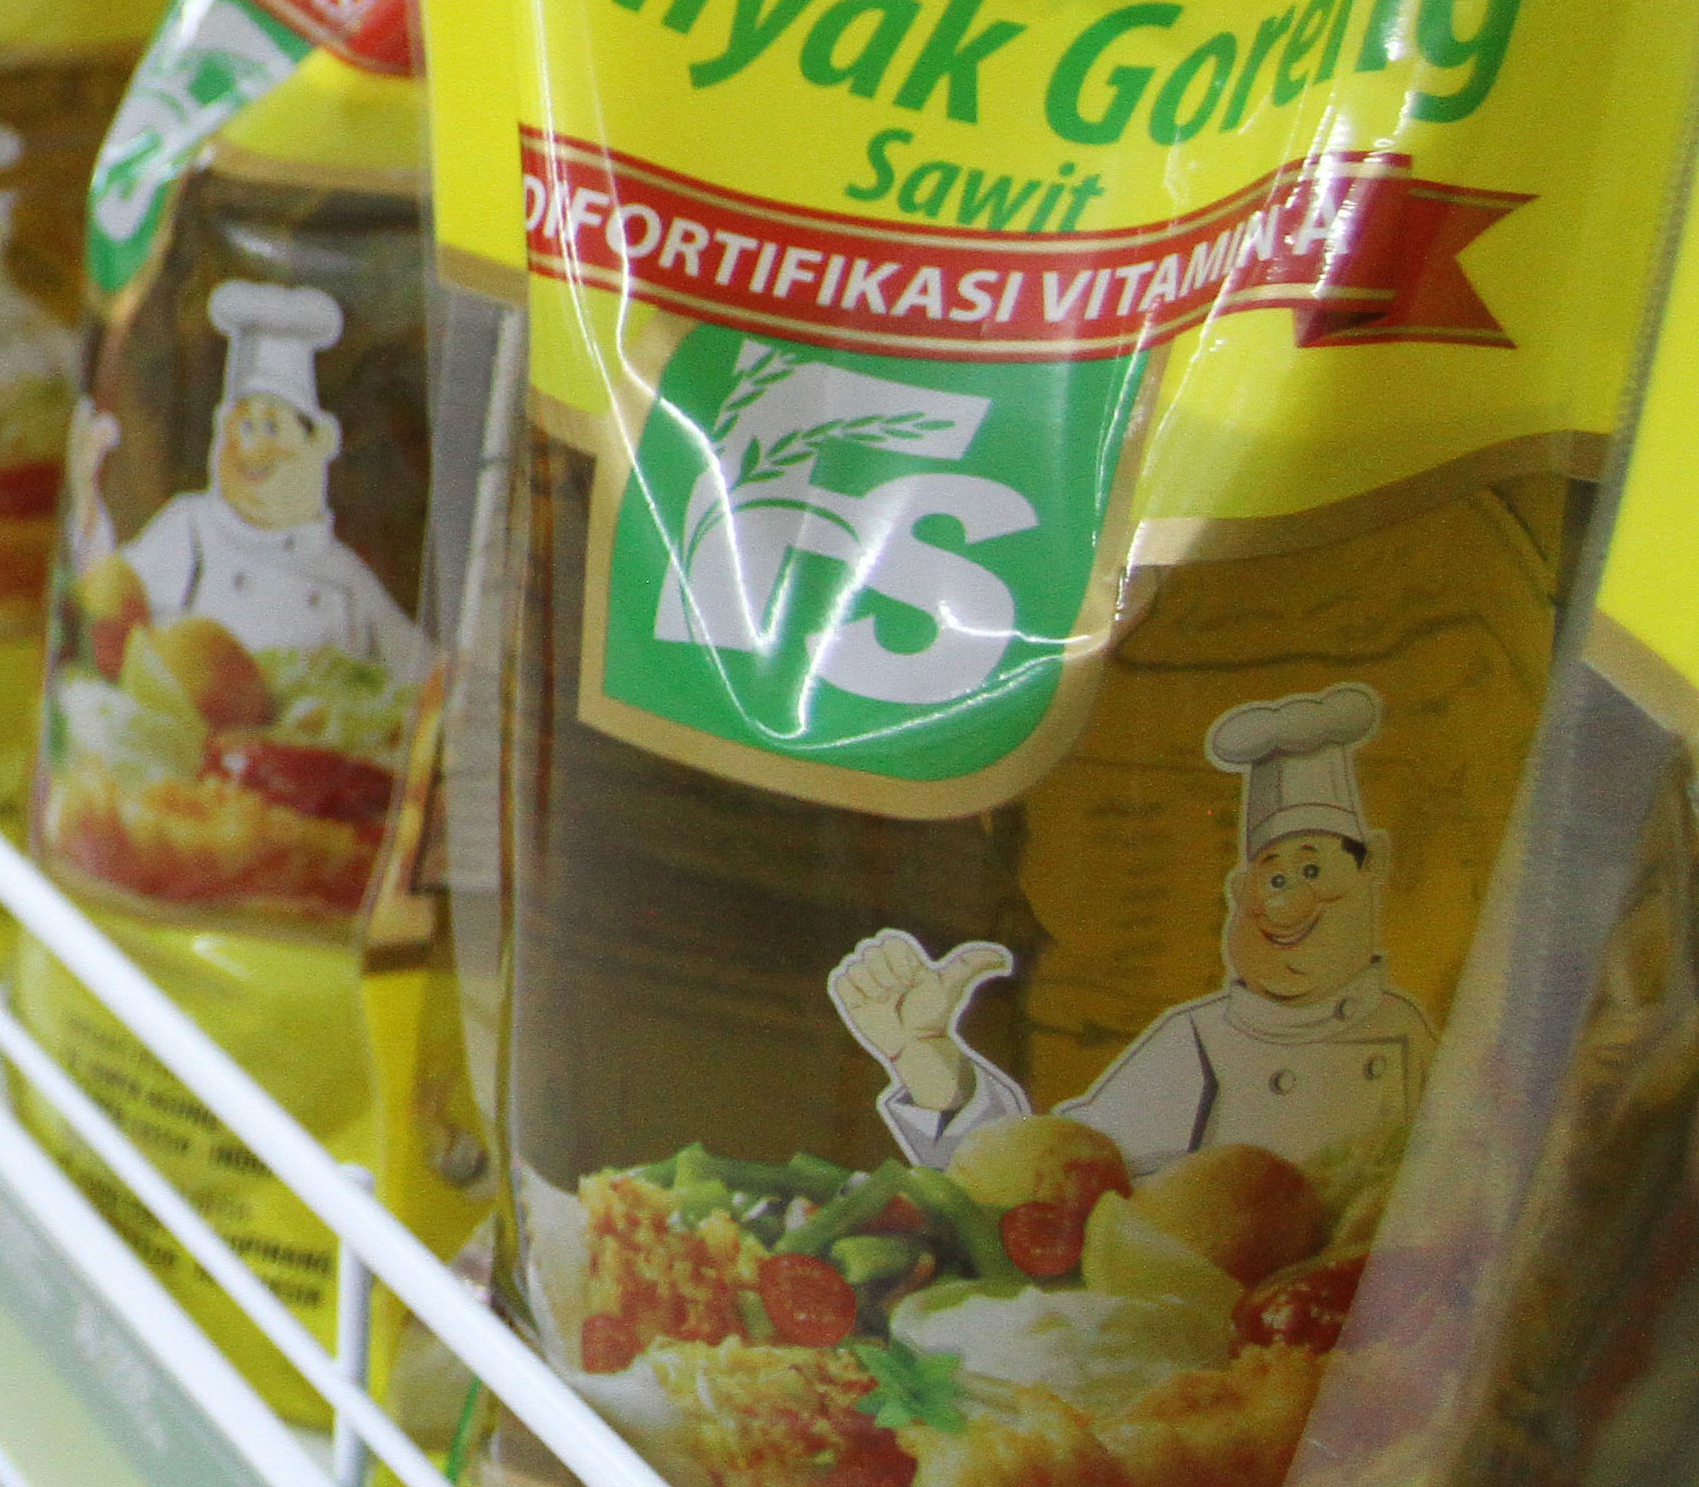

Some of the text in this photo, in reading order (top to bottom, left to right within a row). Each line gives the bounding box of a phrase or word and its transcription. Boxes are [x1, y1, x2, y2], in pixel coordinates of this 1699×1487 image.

[521, 173, 1351, 325] DIFORTIFIKASI VITAMIN A
[844, 128, 1106, 235] Sawit
[652, 337, 1040, 705] FS
